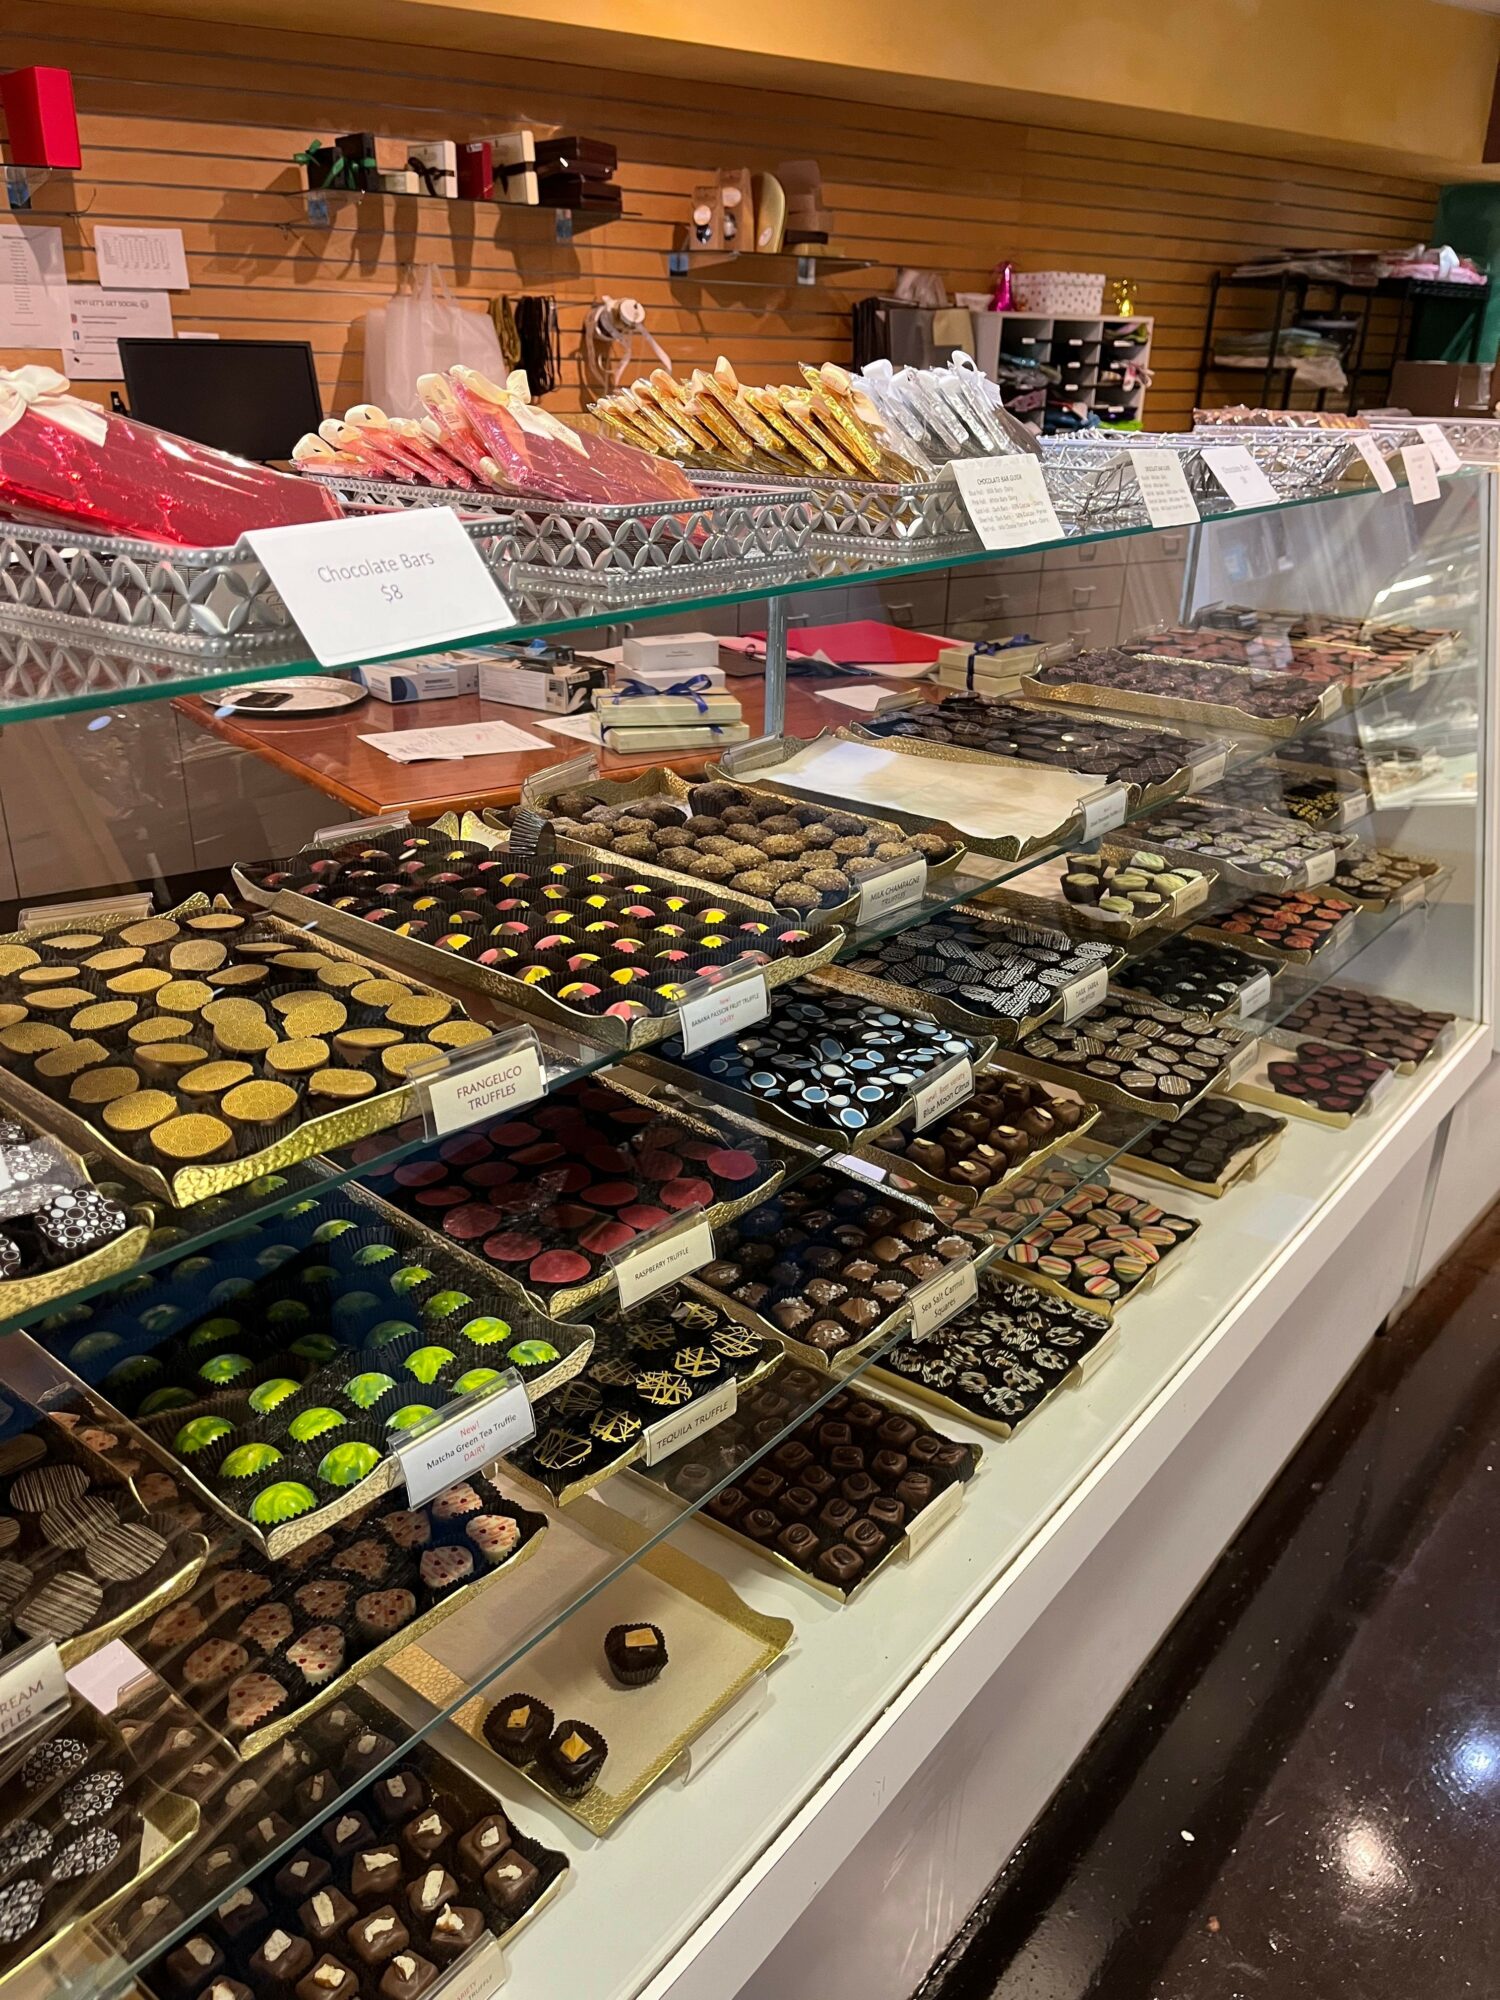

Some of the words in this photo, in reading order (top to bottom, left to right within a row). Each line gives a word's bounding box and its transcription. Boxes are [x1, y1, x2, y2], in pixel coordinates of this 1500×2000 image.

[317, 558, 399, 583] Chocolate
[399, 552, 434, 569] Bars
[380, 584, 403, 603] $8
[870, 890, 885, 901] MILK
[885, 875, 920, 896] CHAMPAGNE
[691, 1015, 710, 1028] BANANA
[710, 1007, 729, 1018] PASSION
[729, 1001, 742, 1010] FRUIT
[742, 993, 760, 1005] TRUFFLE
[456, 1065, 522, 1099] FRANGELICO
[467, 1083, 516, 1110] TRUFFLES
[923, 1105, 935, 1118] Blue
[936, 1092, 954, 1109] Moon
[634, 1260, 666, 1280] RASPBERRY
[666, 1246, 689, 1263] TRUFFLE
[921, 1302, 932, 1313] Sea
[932, 1292, 943, 1305] Salt
[934, 1298, 956, 1318] Squares
[459, 1420, 480, 1438] New!
[656, 1423, 693, 1449] TEQUILA
[694, 1401, 728, 1426] TRUFFLE
[426, 1450, 455, 1470] Matcha
[455, 1436, 479, 1453] Green
[479, 1428, 493, 1440] Tea
[493, 1413, 517, 1431] Truffle
[463, 1443, 487, 1462] DAIRY
